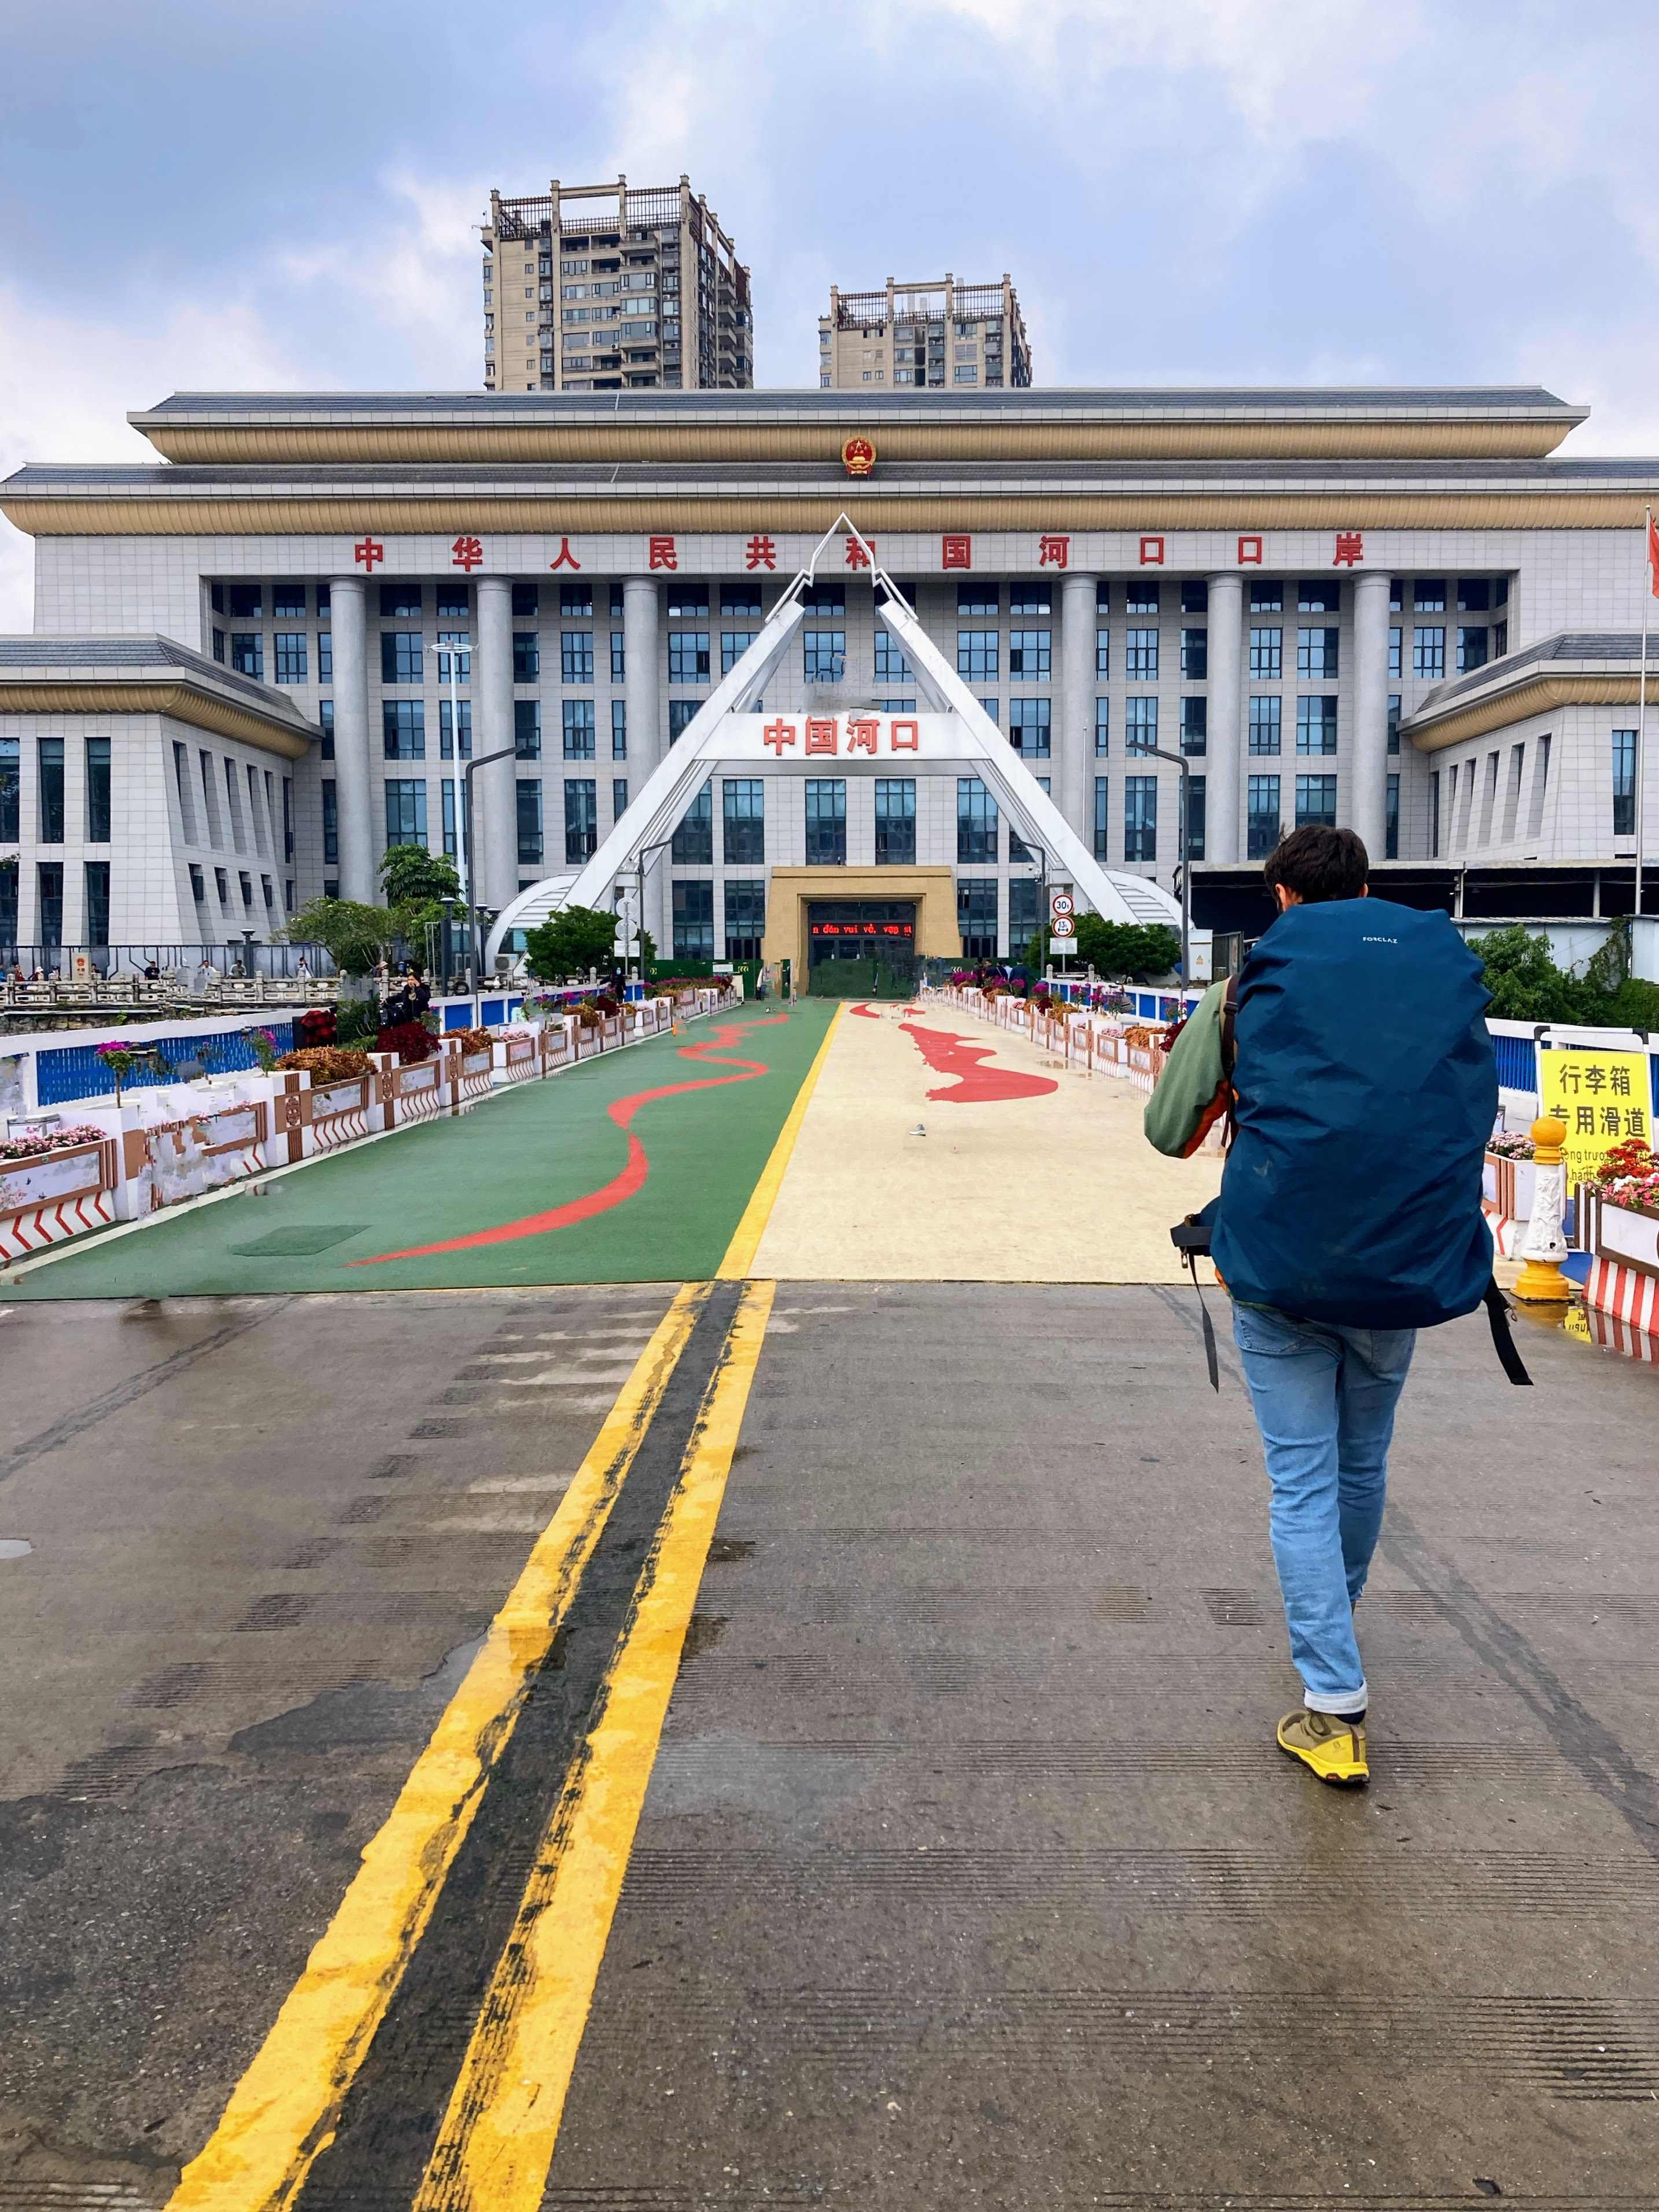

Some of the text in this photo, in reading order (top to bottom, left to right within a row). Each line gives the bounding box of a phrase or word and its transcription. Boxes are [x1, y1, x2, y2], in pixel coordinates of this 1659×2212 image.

[355, 532, 1363, 572] 中华人民共和国河口口岸
[764, 717, 918, 755] 中国河口
[843, 925, 857, 933] vui
[1559, 1063, 1631, 1096] 行李箱
